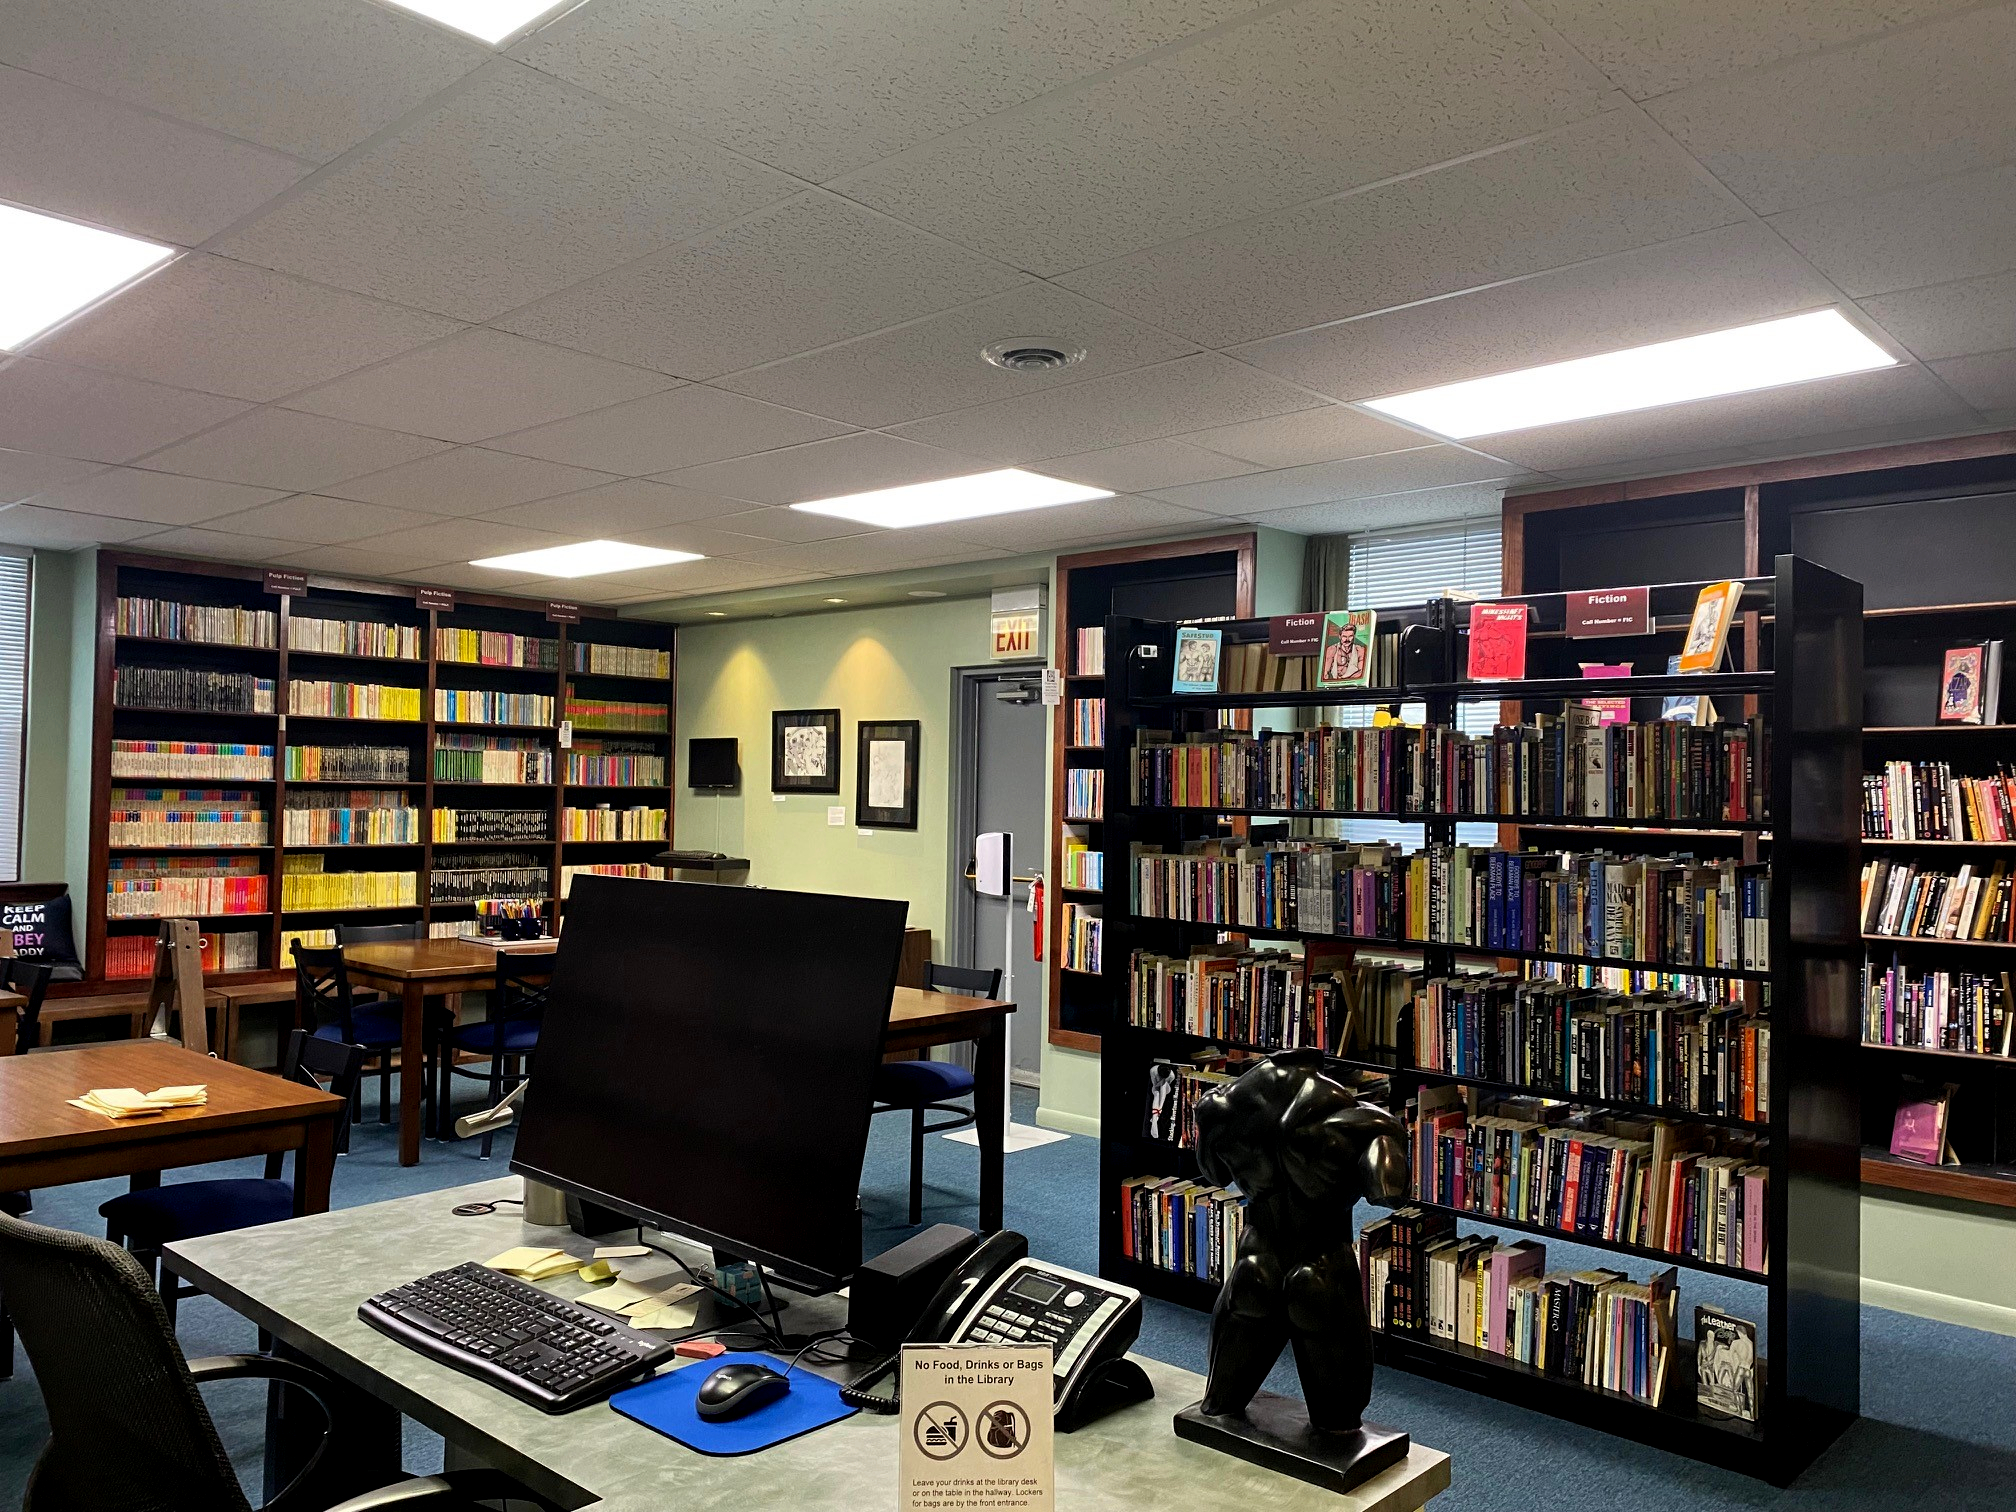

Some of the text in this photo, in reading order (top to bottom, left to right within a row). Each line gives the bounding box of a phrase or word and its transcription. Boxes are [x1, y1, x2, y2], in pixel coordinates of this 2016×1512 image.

[1588, 595, 1627, 604] Fiction
[1285, 618, 1315, 627] Fiction
[1349, 613, 1370, 625] TRASH
[996, 619, 1032, 652] EXIT
[1489, 883, 1497, 901] PLACE
[1496, 888, 1502, 896] TO
[1590, 869, 1598, 906] HOGG
[1606, 882, 1624, 893] MAD
[1606, 892, 1624, 904] MAN
[3, 904, 45, 914] KEEP
[2, 913, 45, 925] CALM
[1606, 906, 1615, 943] DELANY
[1615, 906, 1623, 938] SAMUEL
[12, 924, 34, 933] AND
[14, 933, 44, 947] BEY
[13, 947, 45, 957] ADDY
[1745, 1085, 1754, 1093] 2
[1718, 1187, 1727, 1204] FUNERAL
[1551, 1287, 1562, 1319] MASTER
[1551, 1324, 1560, 1332] O
[1708, 1315, 1737, 1331] Leather
[915, 1359, 1044, 1371] No Food, Drinks or Bags
[944, 1374, 1015, 1386] in the Library
[912, 1479, 934, 1487] Leave
[953, 1478, 975, 1486] drinks
[984, 1478, 996, 1486] the
[997, 1478, 1019, 1487] library
[985, 1488, 1014, 1497] hallway.
[1016, 1488, 1043, 1496] Lockers
[923, 1500, 941, 1508] bags
[956, 1500, 965, 1508] by
[966, 1499, 978, 1507] the
